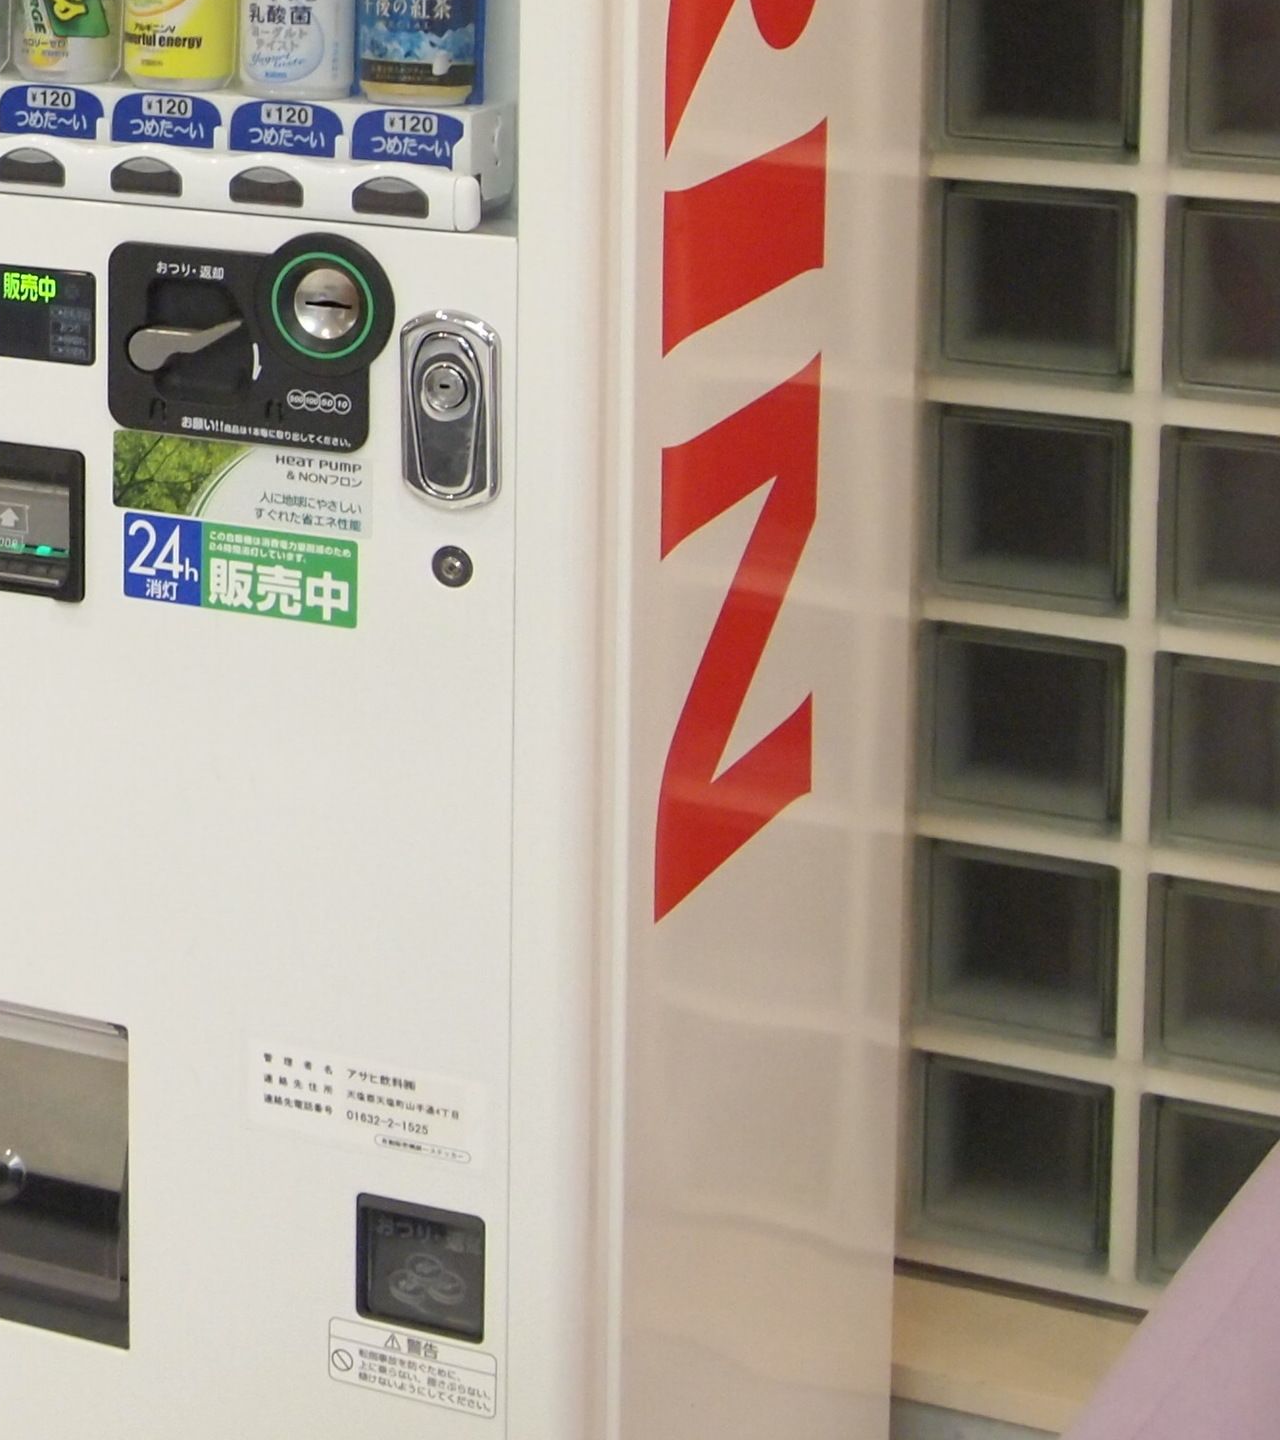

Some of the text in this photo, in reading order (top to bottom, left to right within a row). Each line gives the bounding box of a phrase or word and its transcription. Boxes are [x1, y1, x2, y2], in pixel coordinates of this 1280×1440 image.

[249, 4, 312, 25] 乳酸菌
[159, 36, 202, 49] energy
[146, 99, 189, 116] ¥120
[266, 107, 309, 124] ¥120
[2, 271, 57, 304] 販売中
[286, 471, 362, 488] & NONフロン
[259, 492, 362, 514] 人に地球にやさしい
[254, 507, 362, 532] すぐれた省エネ性能
[145, 578, 178, 601] 消灯
[208, 558, 349, 621] 販売中
[346, 1110, 429, 1135] 01632-2-1525
[406, 1337, 439, 1360] 警告
